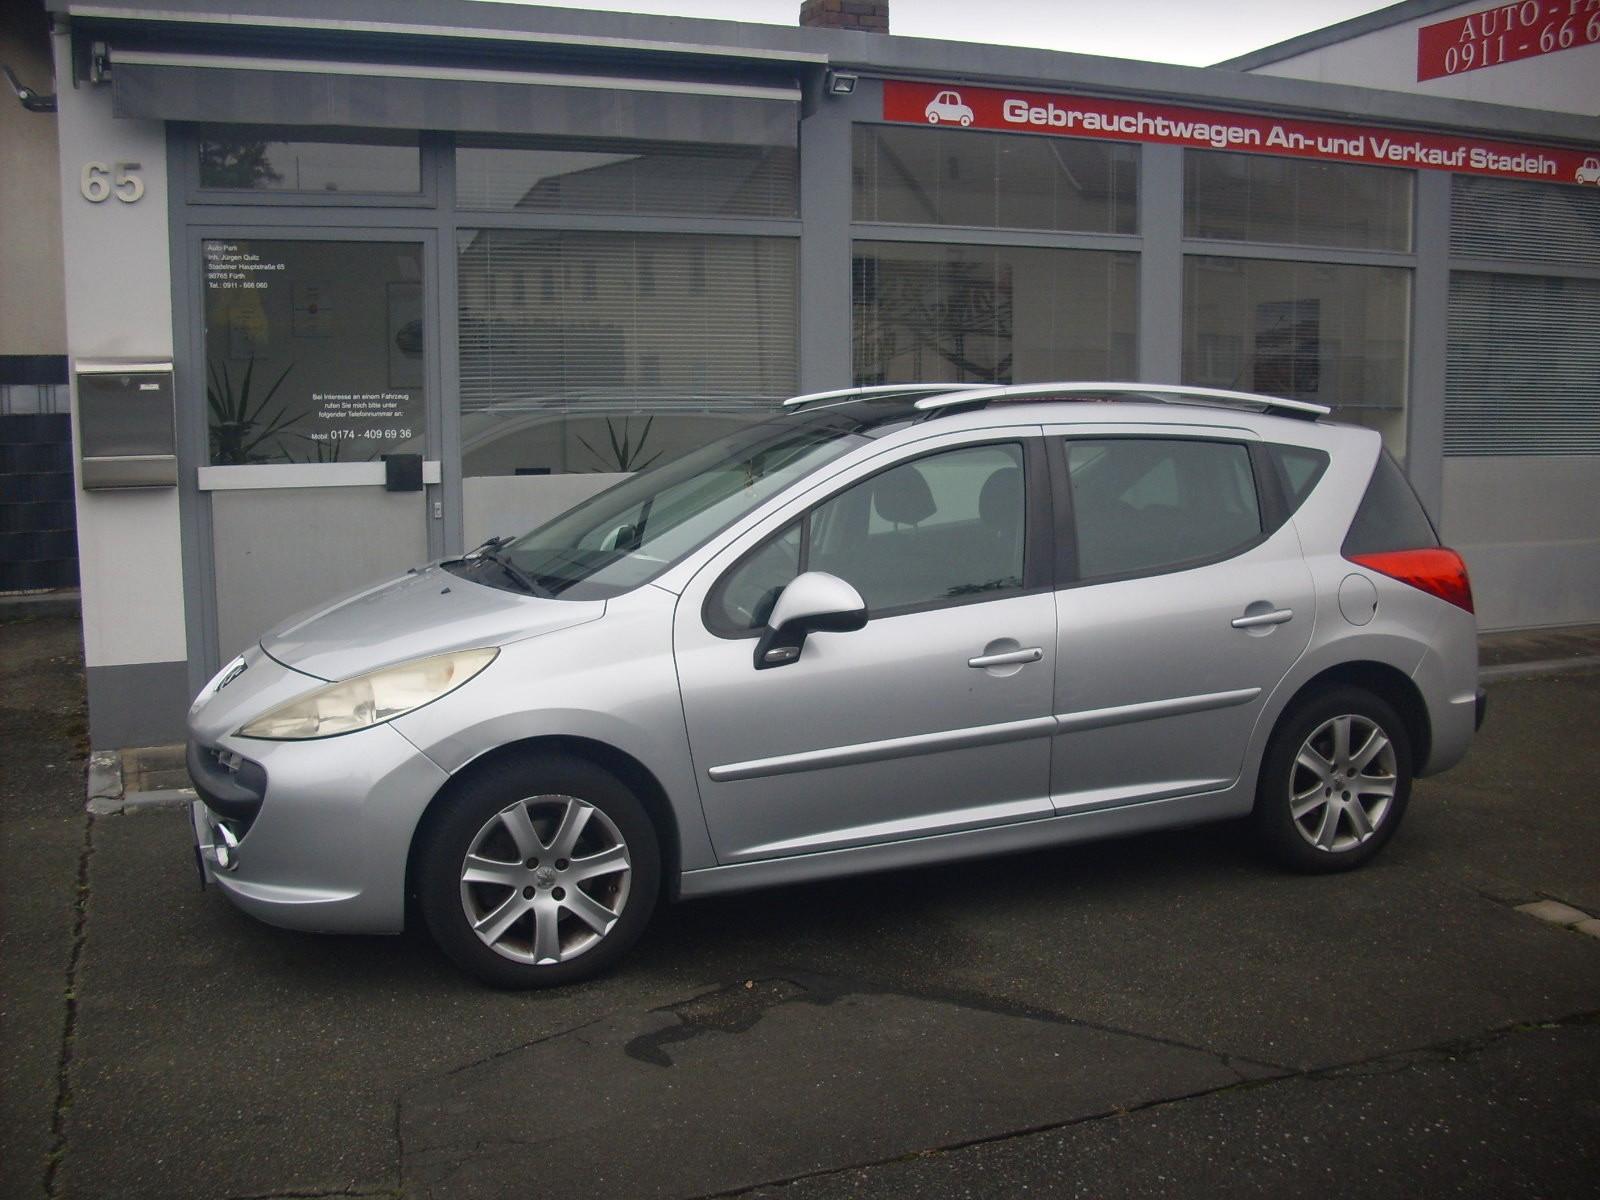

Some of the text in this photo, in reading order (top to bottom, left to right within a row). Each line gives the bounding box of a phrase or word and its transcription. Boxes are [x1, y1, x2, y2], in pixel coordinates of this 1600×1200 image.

[1459, 0, 1539, 43] AUTO
[1444, 35, 1505, 74] 0911
[1540, 17, 1574, 53] 66
[1003, 99, 1260, 148] Gebrauchtwagen
[1369, 137, 1467, 167] Verkauf
[1470, 148, 1556, 175] Stadeln
[81, 161, 144, 203] 65
[381, 393, 409, 401] Fahrzeug
[330, 429, 355, 439] 0174
[363, 429, 383, 439] 409
[384, 429, 397, 439] 69
[400, 429, 412, 439] 36
